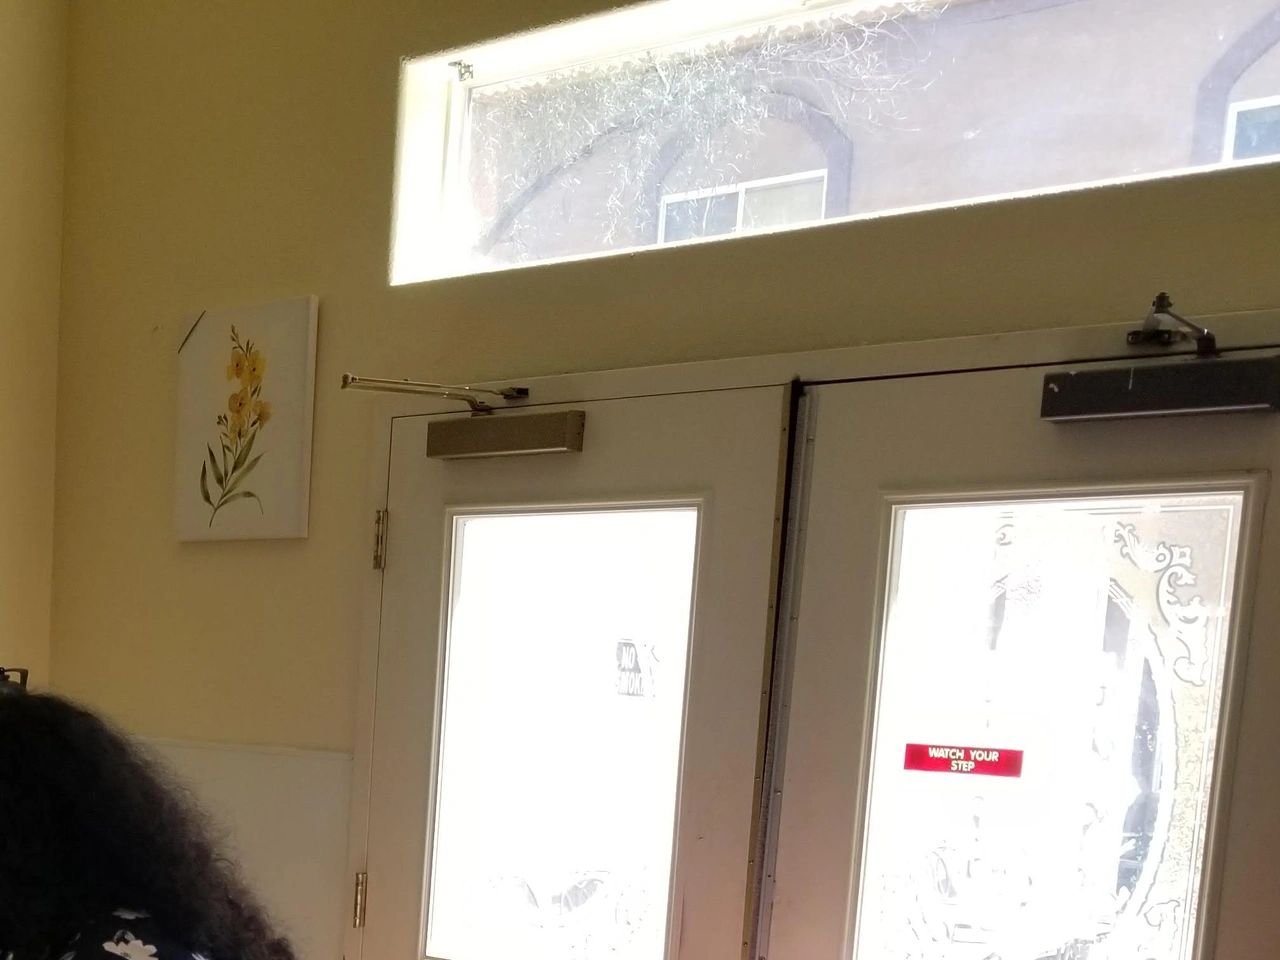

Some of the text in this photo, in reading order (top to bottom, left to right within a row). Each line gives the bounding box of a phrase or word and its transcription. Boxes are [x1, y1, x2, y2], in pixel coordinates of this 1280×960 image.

[928, 747, 999, 762] WATCH YOUR
[951, 760, 975, 772] STEP
